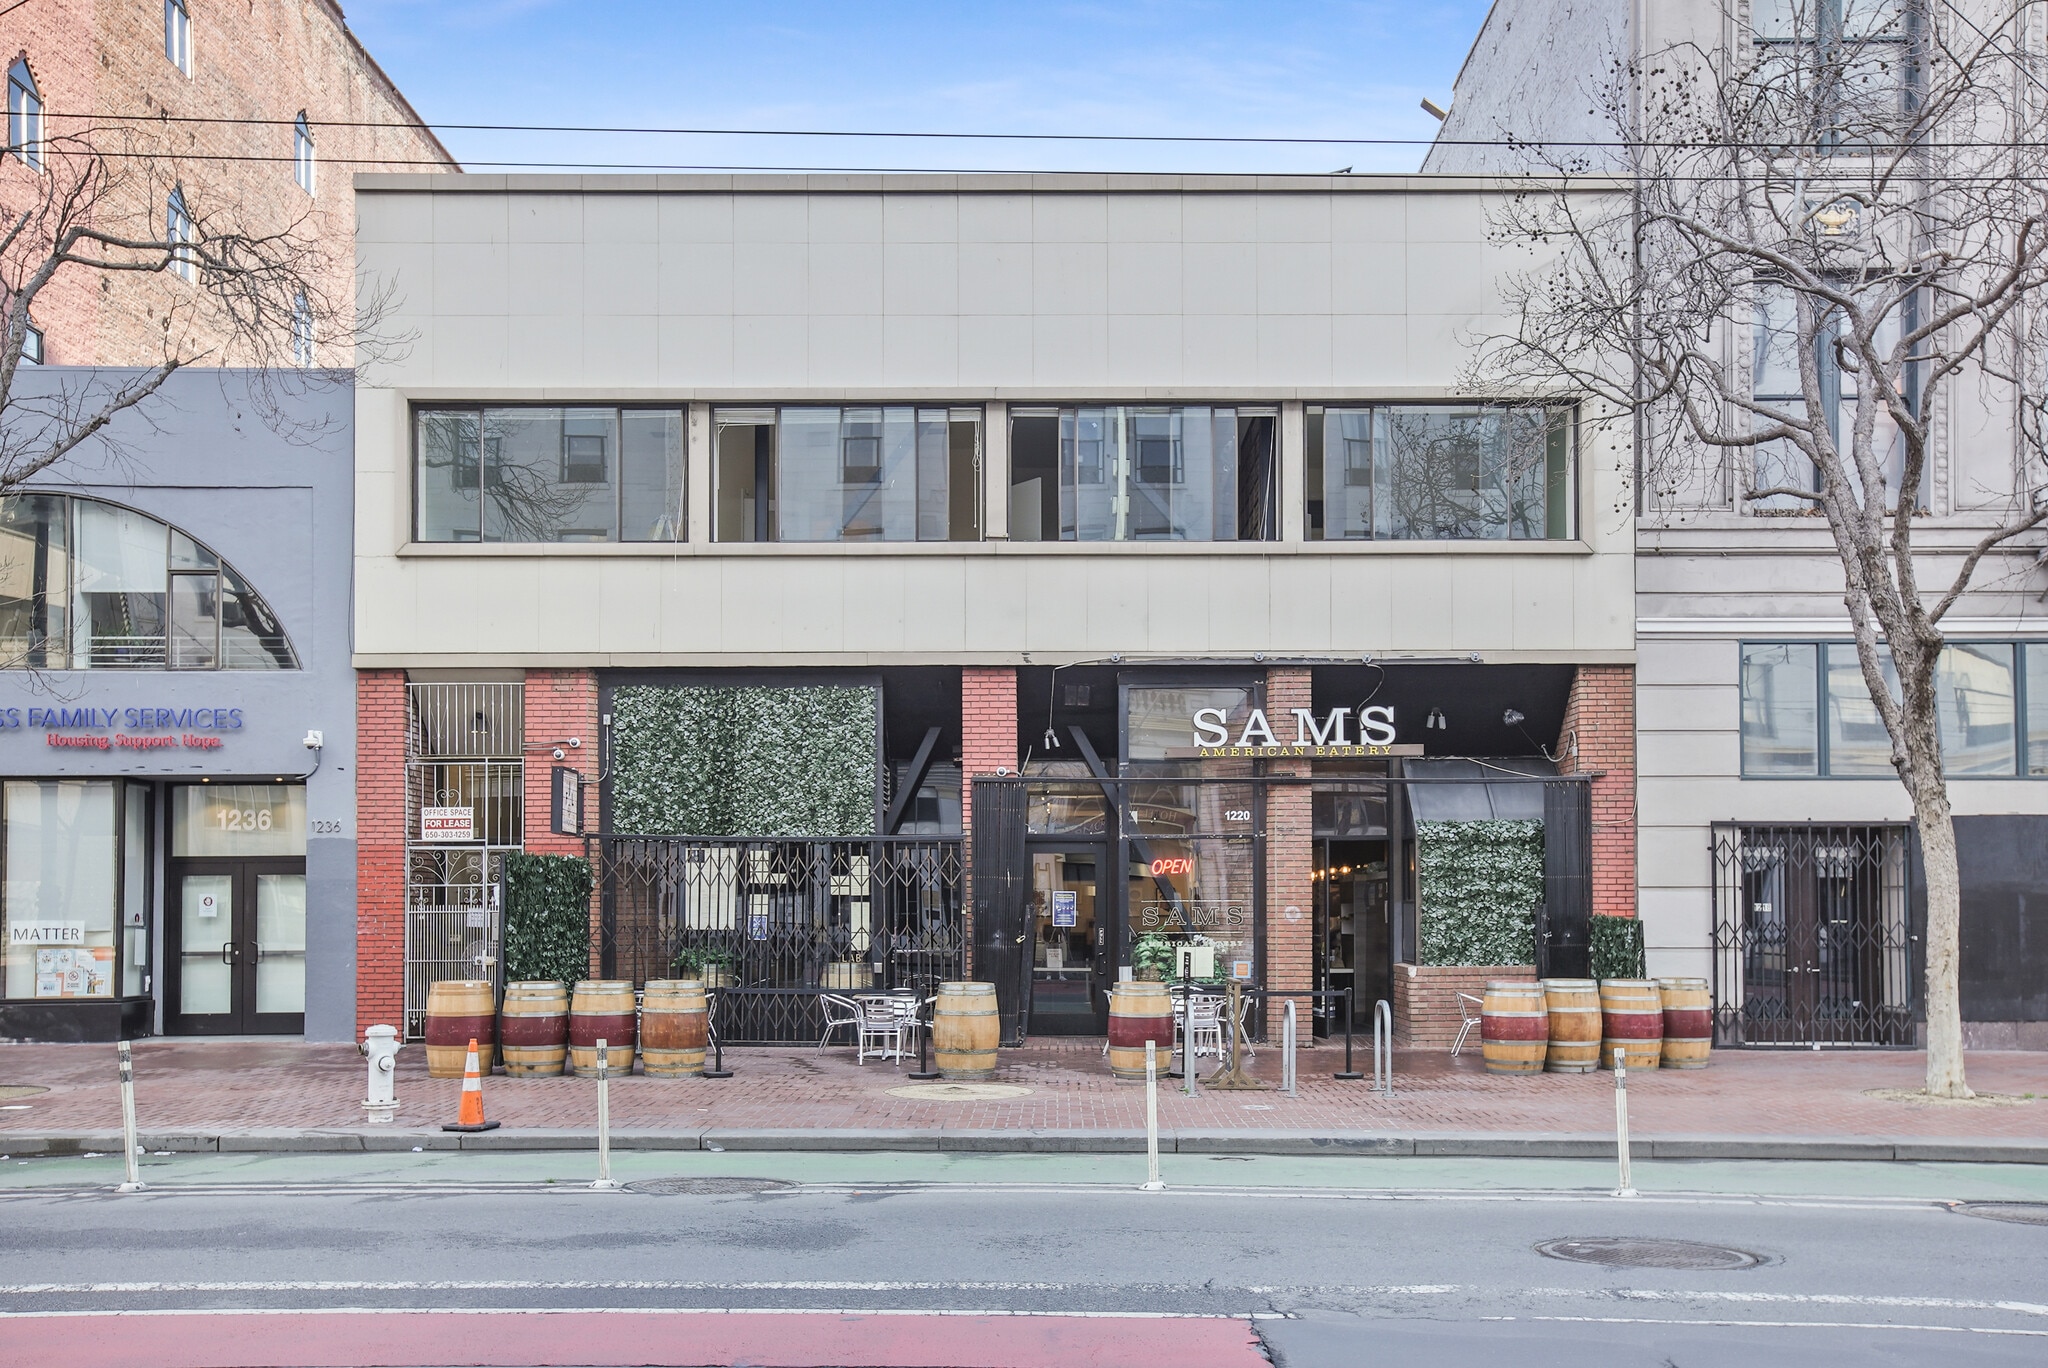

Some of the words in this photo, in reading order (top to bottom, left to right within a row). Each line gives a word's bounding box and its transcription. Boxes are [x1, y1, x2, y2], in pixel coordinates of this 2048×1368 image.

[28, 707, 118, 728] FAMILY
[124, 707, 243, 729] SERVICES
[1193, 706, 1396, 747] SAMS
[1199, 745, 1305, 757] AMERICAN
[1315, 745, 1392, 756] EATERY
[423, 808, 448, 816] OFFICE
[449, 808, 472, 816] SPACE
[1224, 810, 1251, 821] 1220
[217, 809, 271, 831] 1236
[311, 820, 342, 833] 1236
[425, 819, 442, 828] FOR
[443, 819, 471, 828] LEASE
[425, 830, 471, 839] 650-303-1259
[1151, 859, 1193, 875] OPEN
[1142, 906, 1243, 926] SAMS
[13, 927, 79, 940] MATTER
